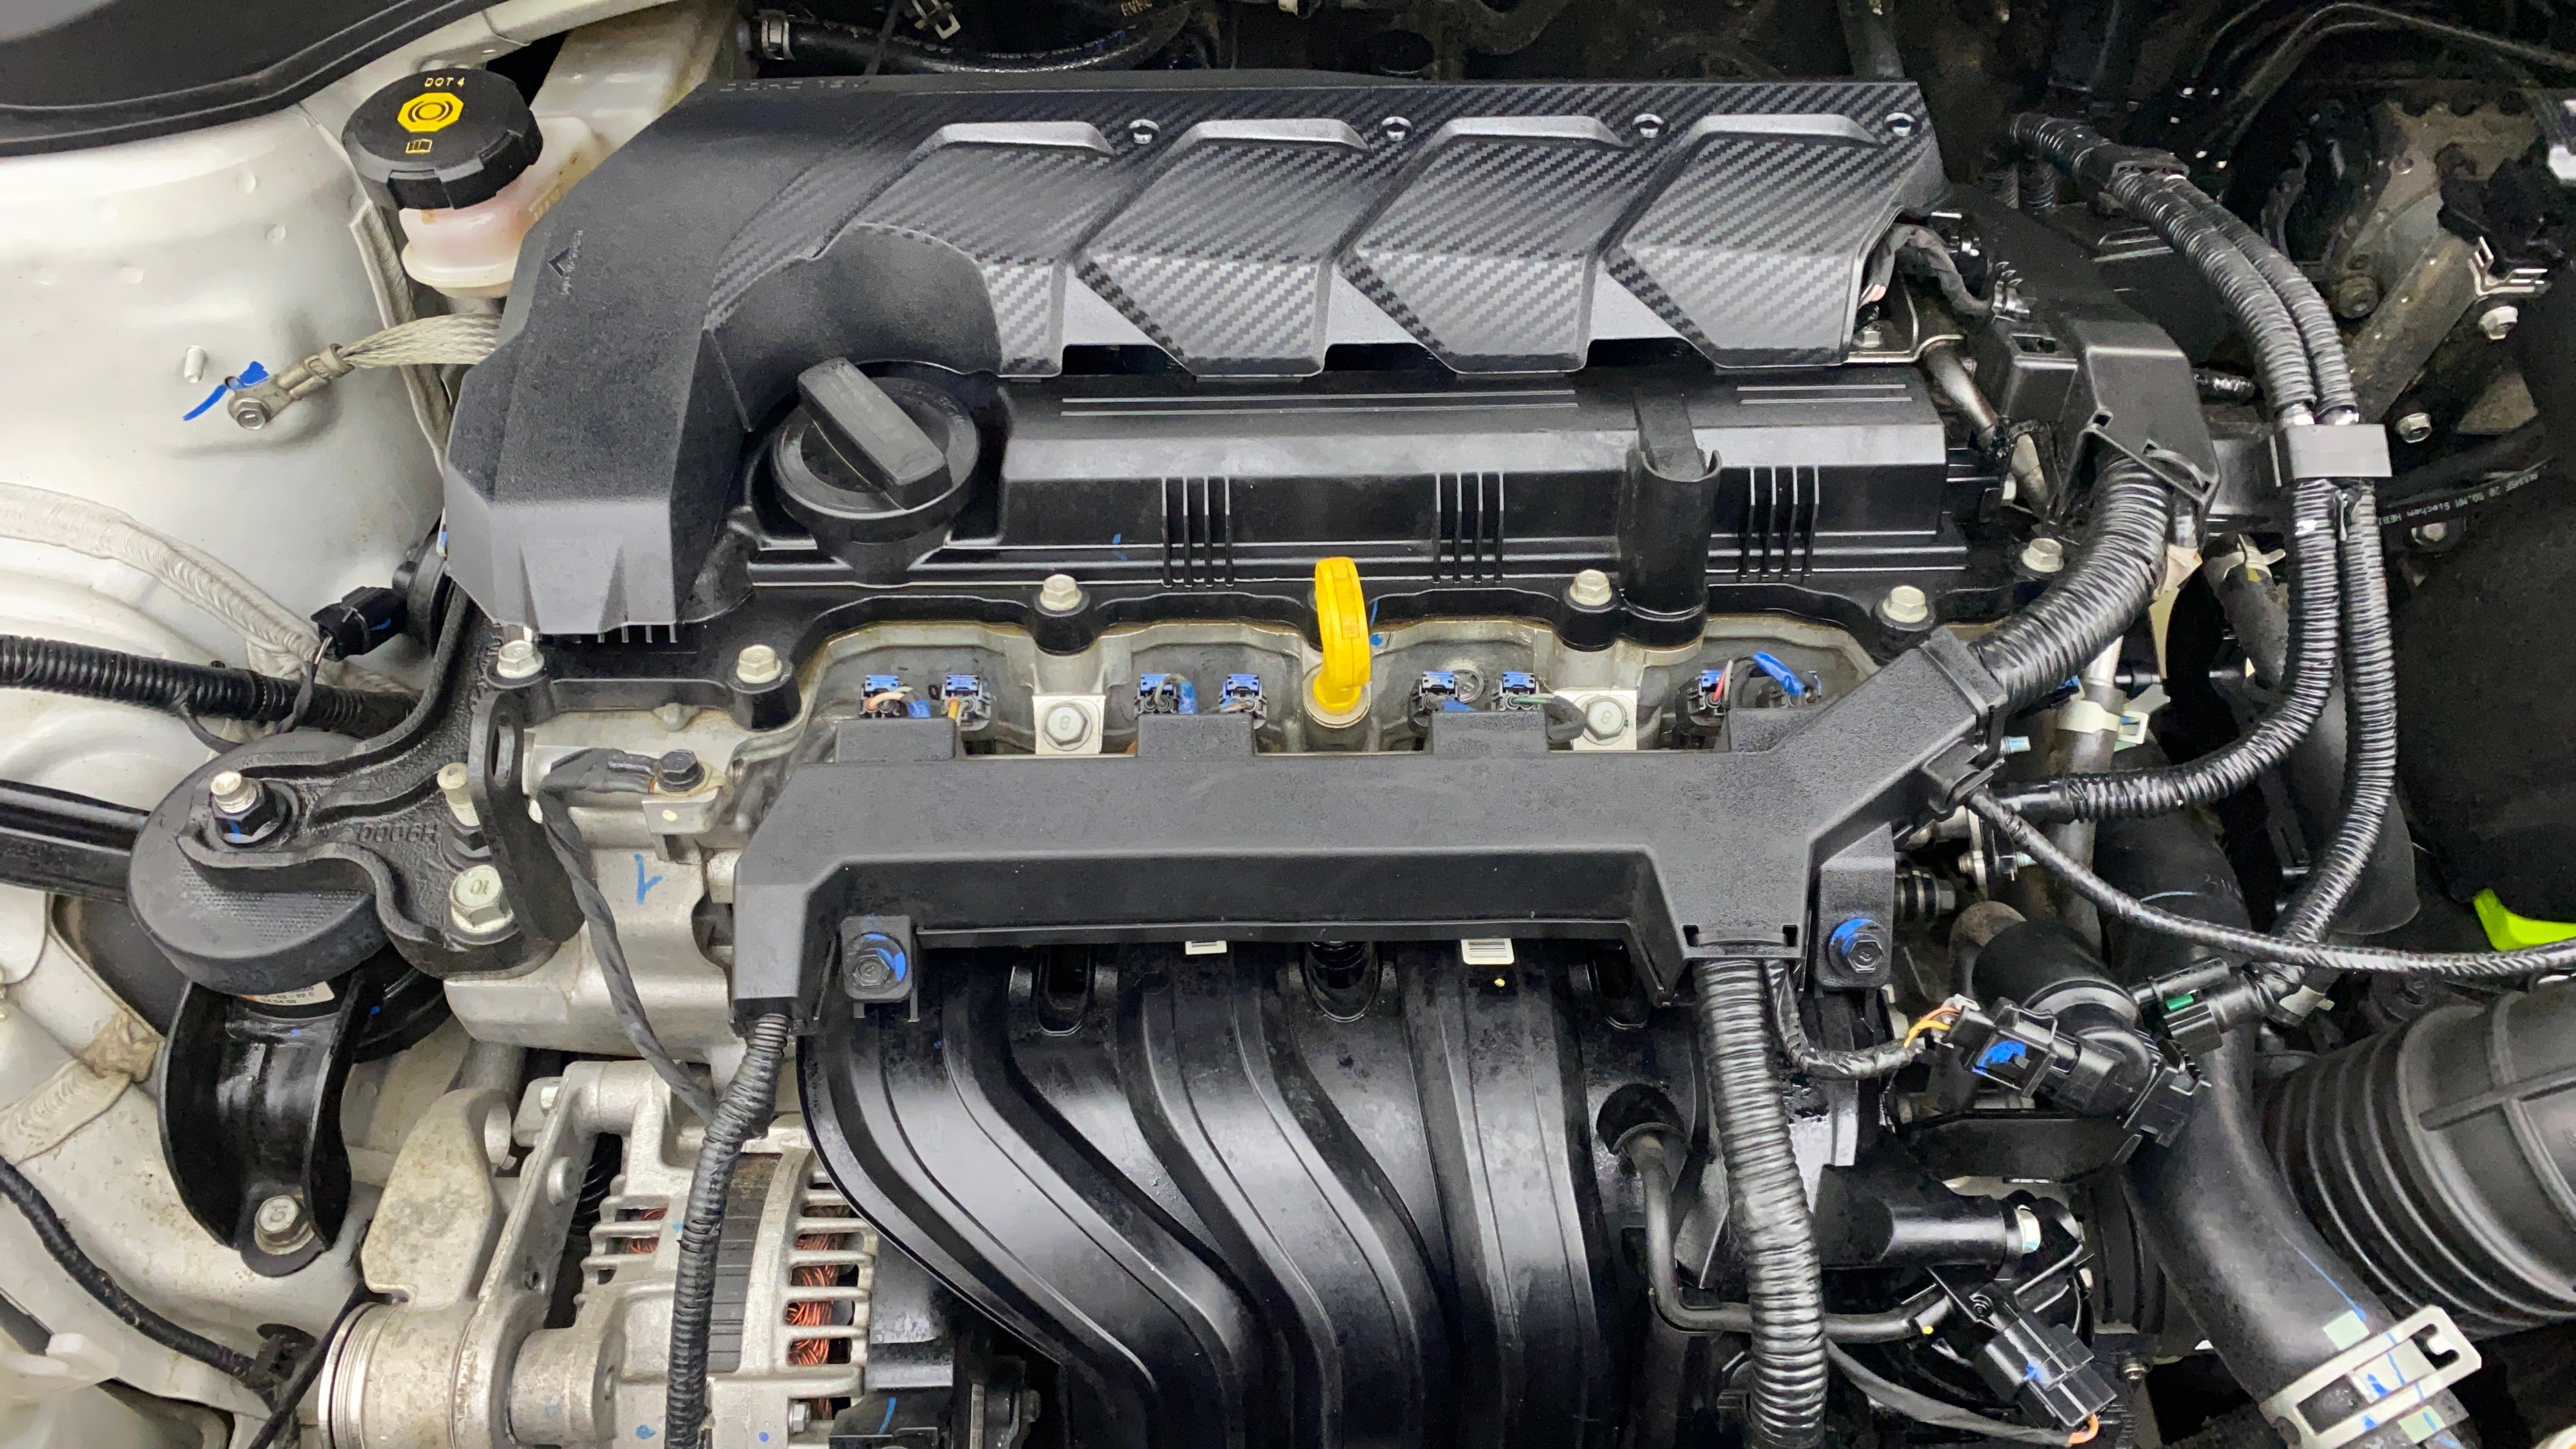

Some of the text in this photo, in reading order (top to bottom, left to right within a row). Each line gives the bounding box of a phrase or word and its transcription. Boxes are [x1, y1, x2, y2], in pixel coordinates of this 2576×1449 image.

[424, 77, 465, 87] DOT 4
[1059, 715, 1071, 731] 8
